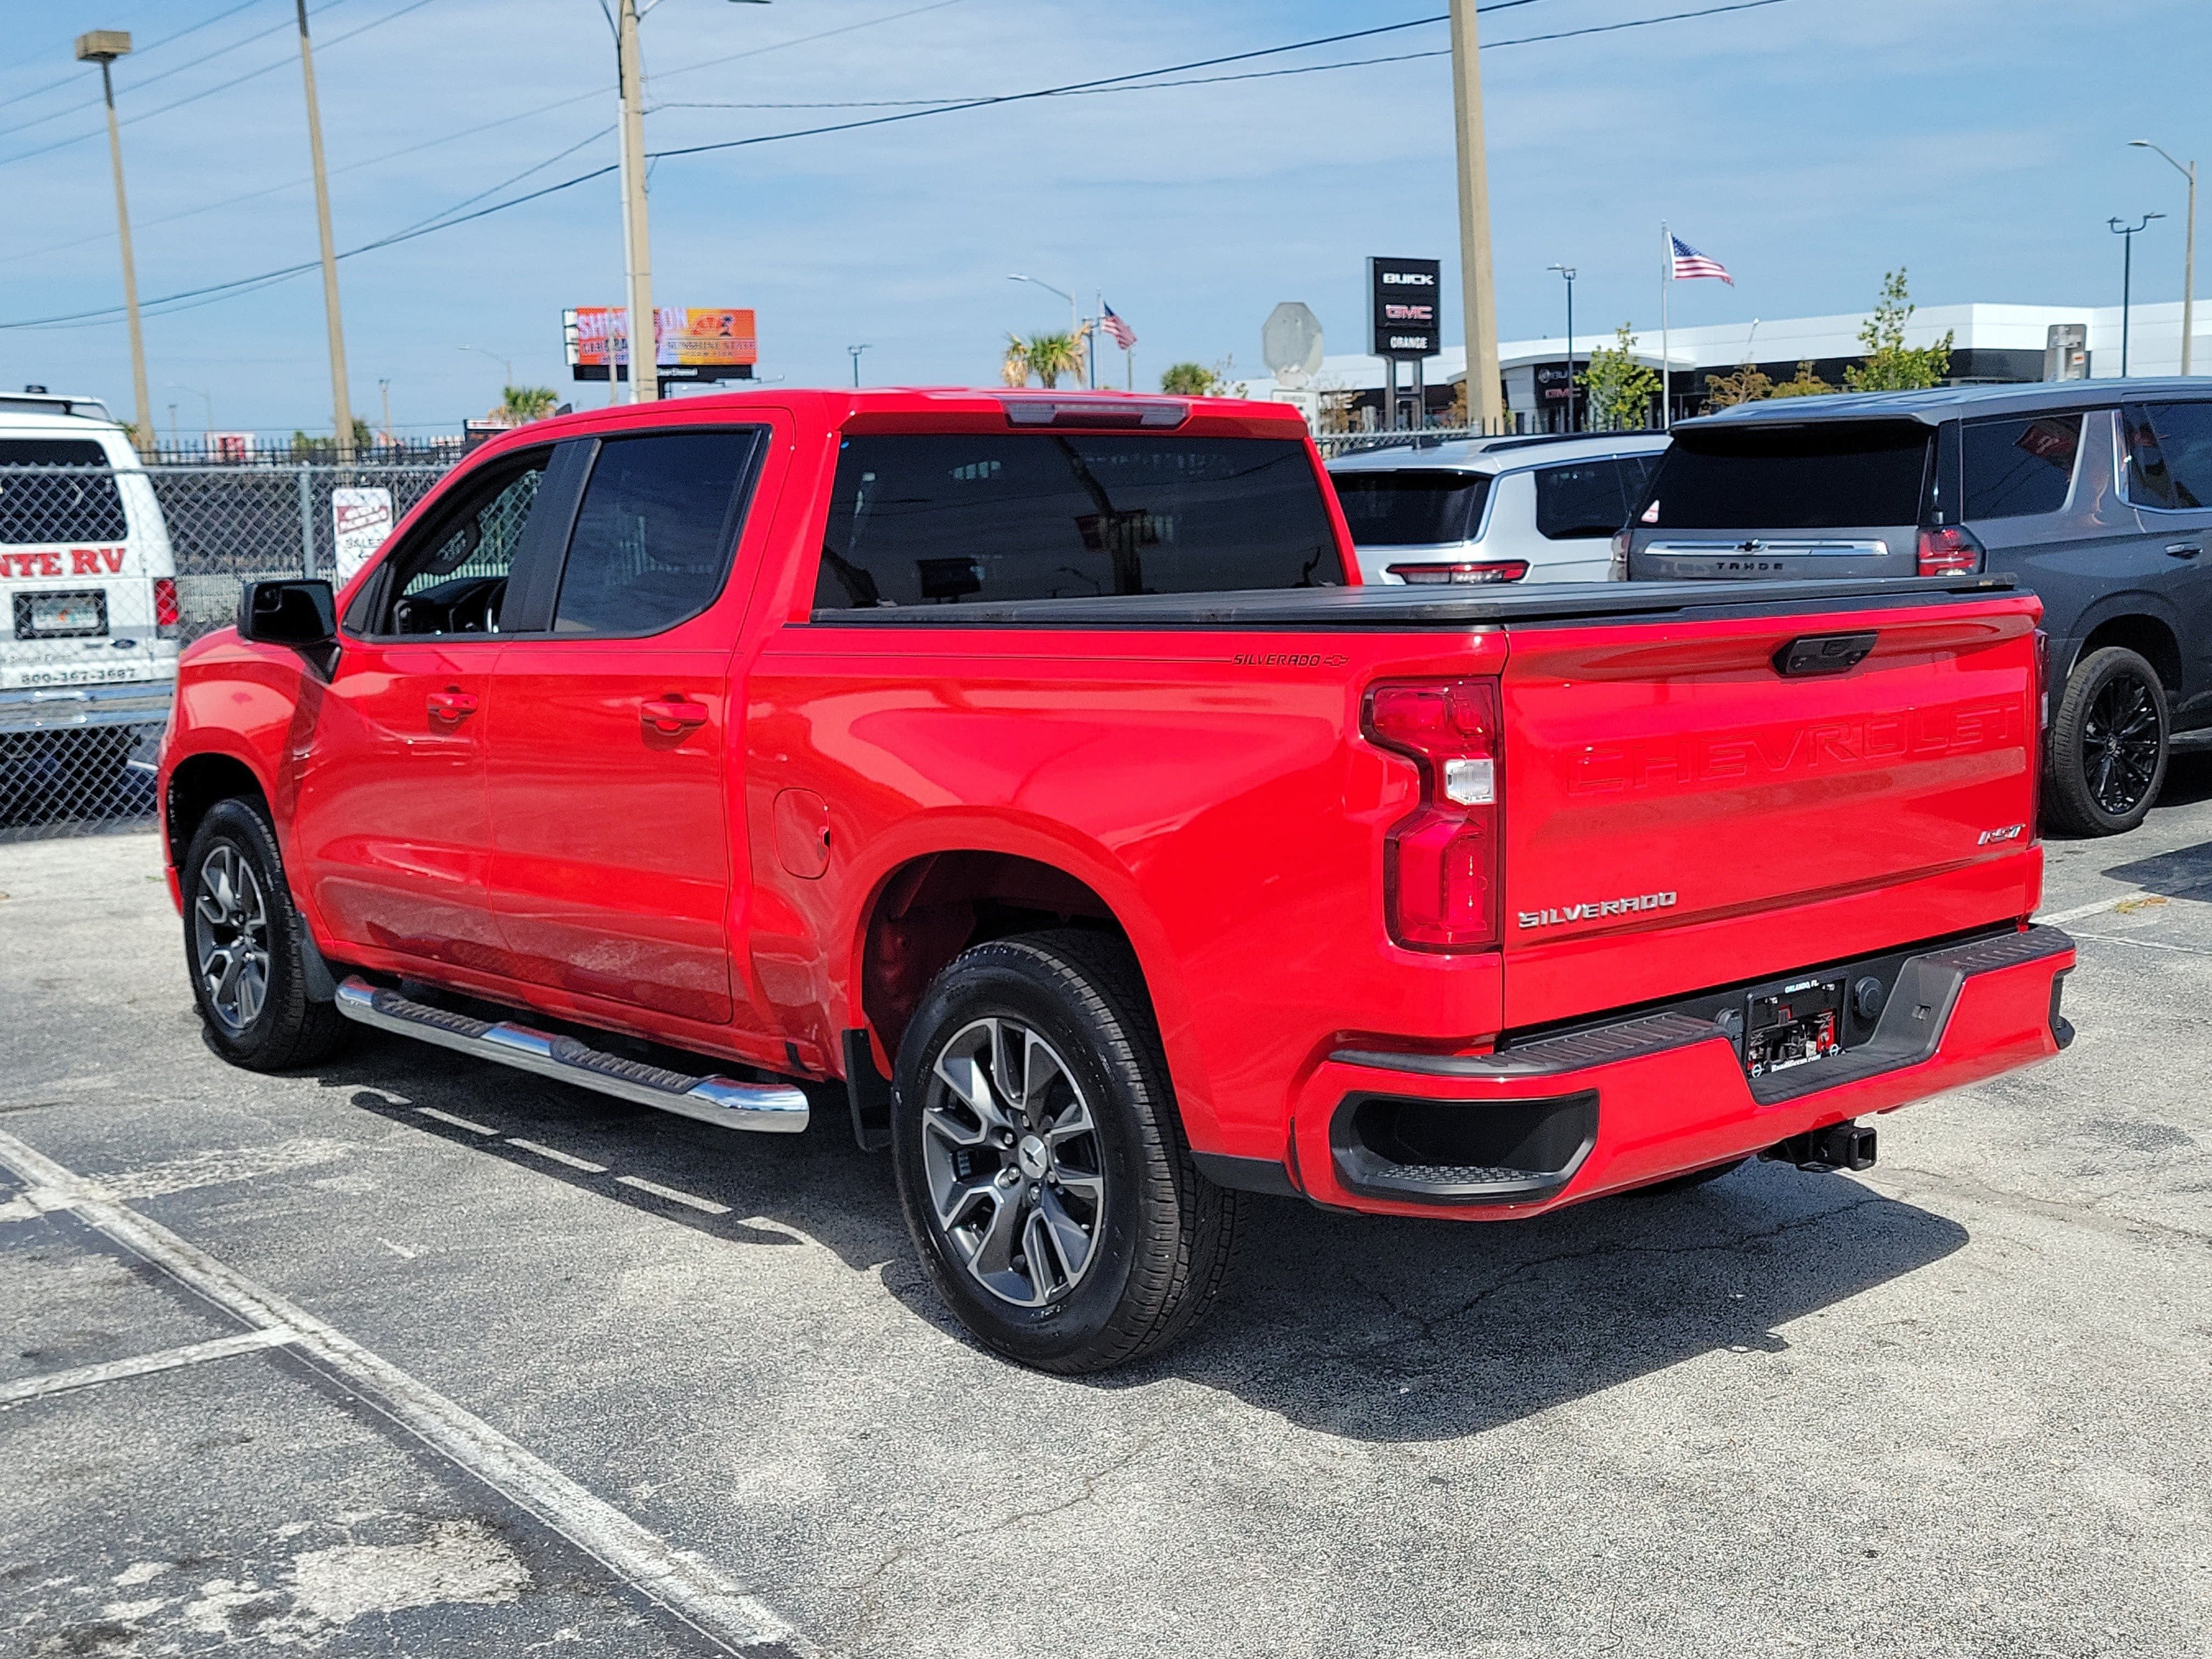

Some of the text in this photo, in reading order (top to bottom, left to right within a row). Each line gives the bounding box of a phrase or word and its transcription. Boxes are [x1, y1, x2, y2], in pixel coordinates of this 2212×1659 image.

[1383, 273, 1435, 285] BUICK
[1385, 304, 1433, 319] GMC
[1390, 336, 1428, 349] ORANGE
[70, 548, 126, 574] RV
[1716, 562, 1784, 570] TAHOE
[1234, 654, 1321, 666] SILVERADO
[1567, 702, 2020, 796] CHEVROLET
[1517, 890, 1677, 928] SILVERADO
